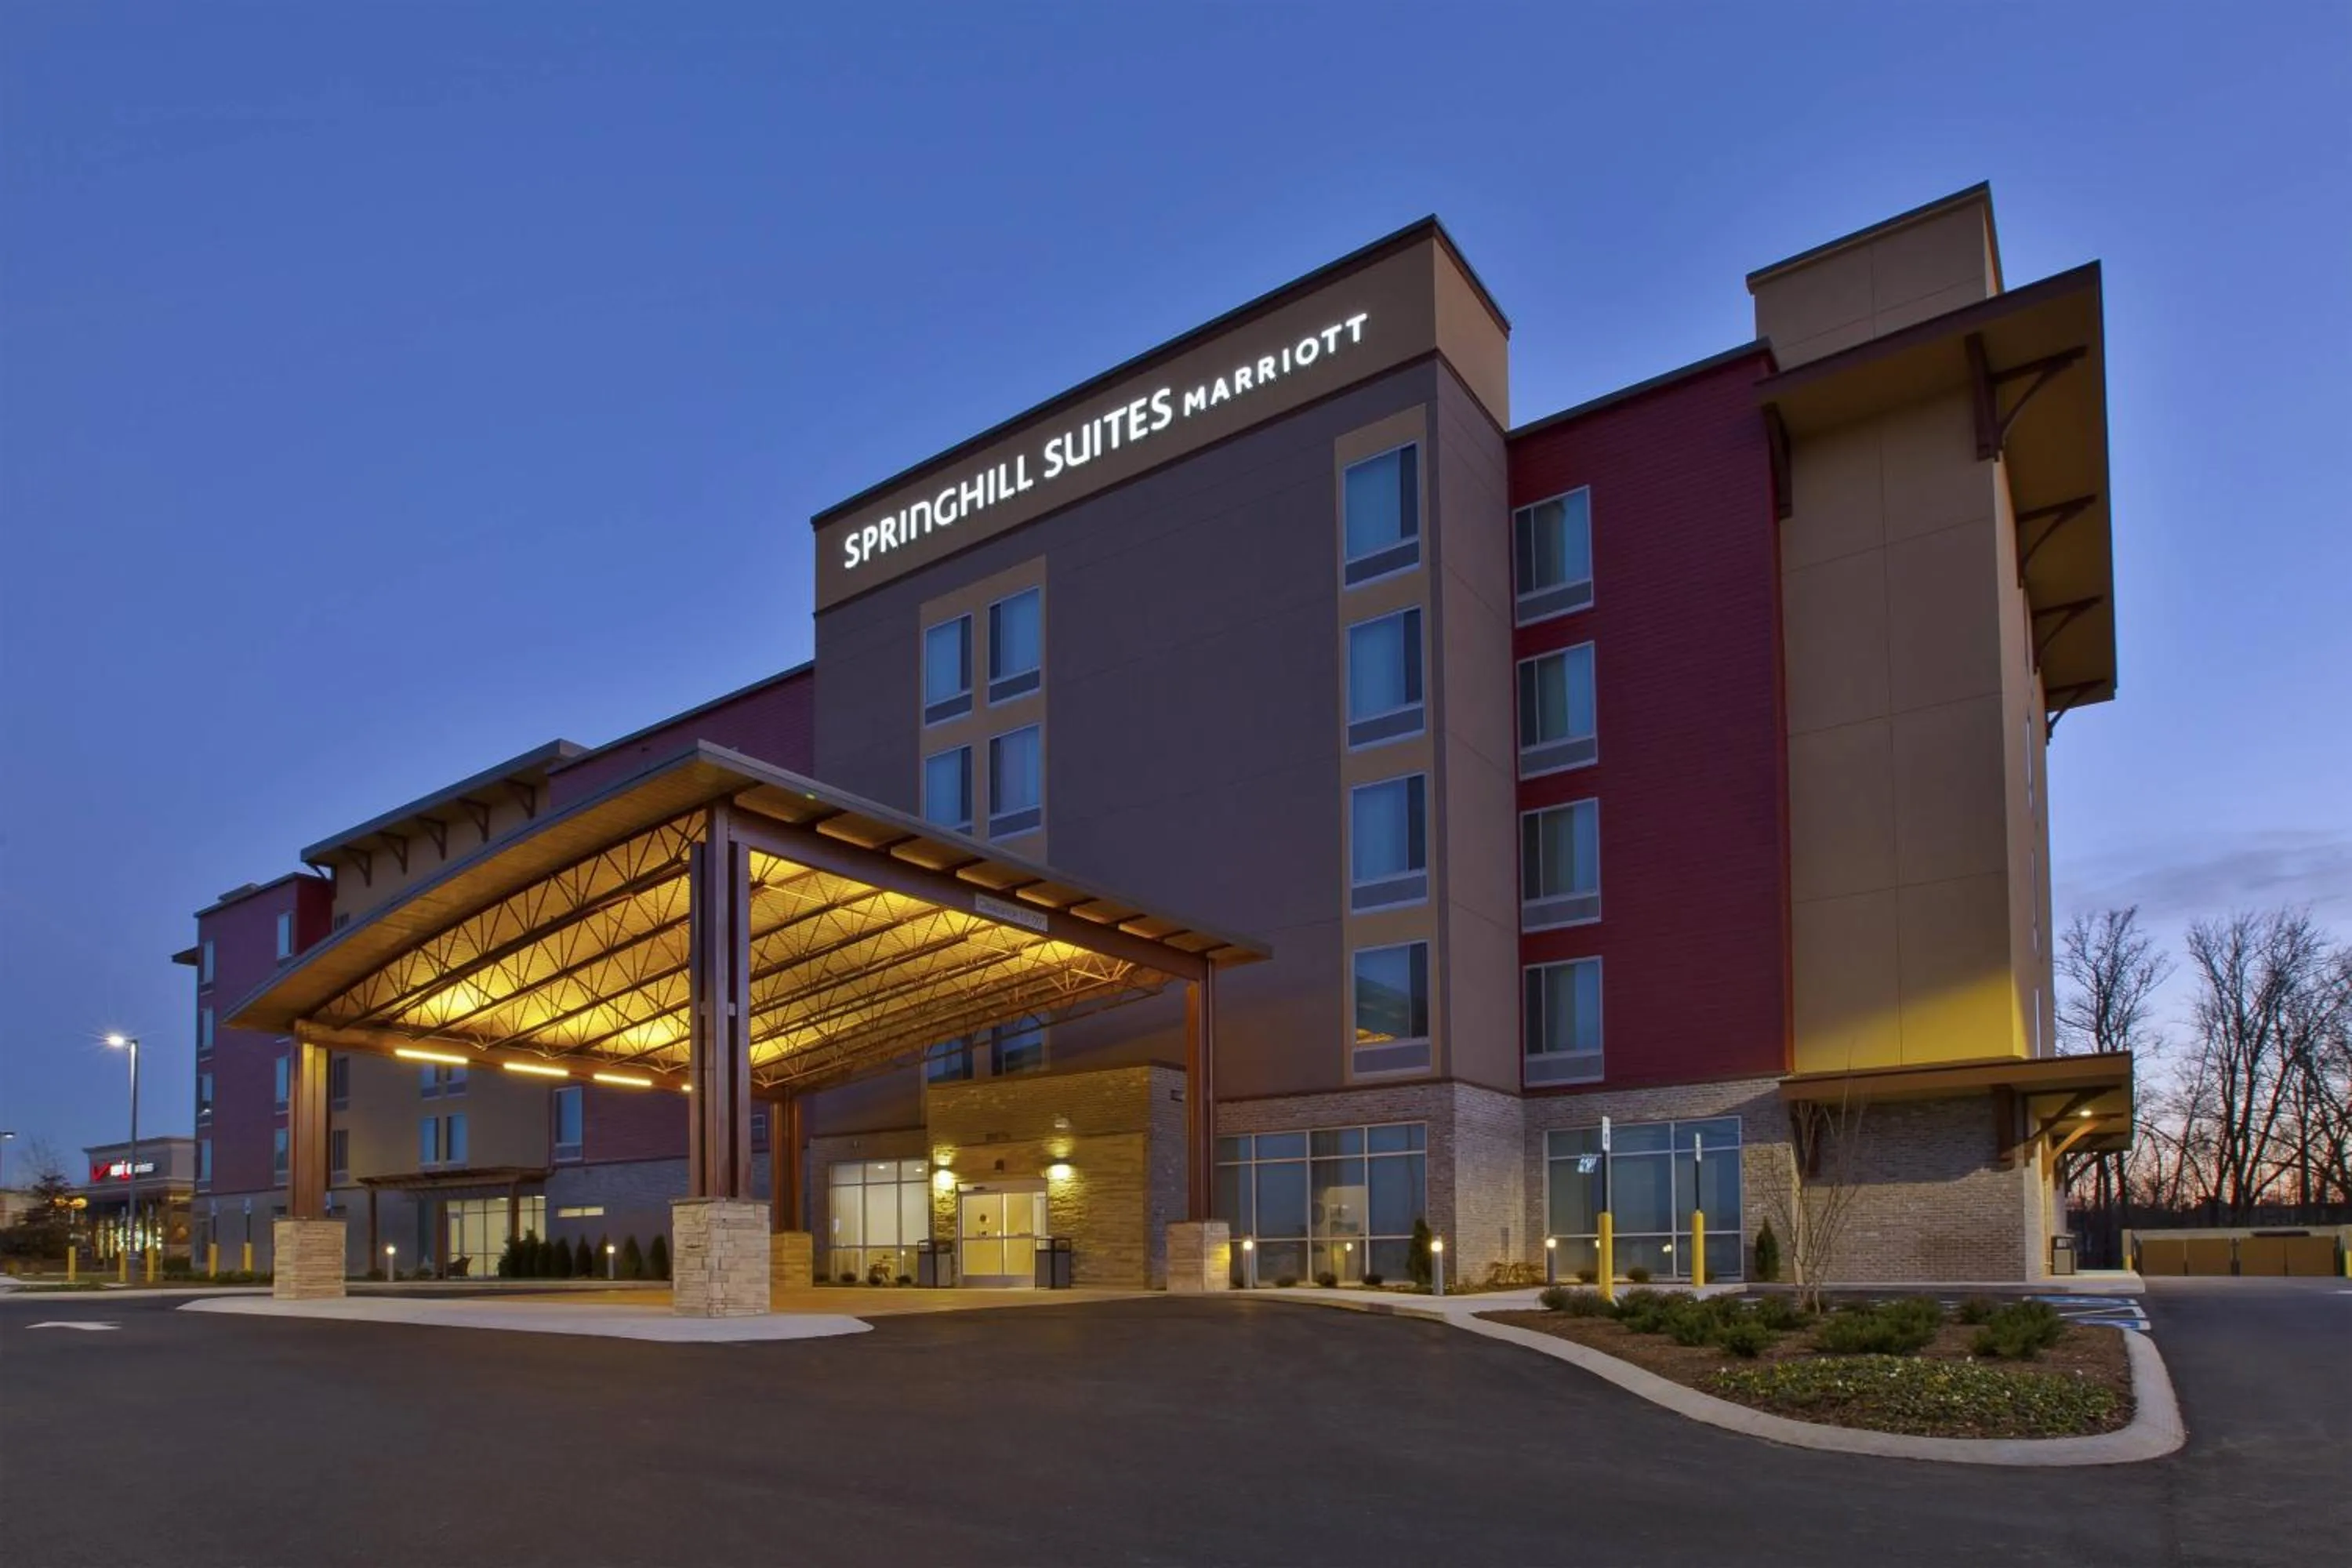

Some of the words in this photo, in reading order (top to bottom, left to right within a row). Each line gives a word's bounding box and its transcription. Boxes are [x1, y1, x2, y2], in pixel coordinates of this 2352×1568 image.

[844, 454, 1034, 569] SPRINGHILL
[1042, 387, 1173, 478] SUITES
[1182, 312, 1369, 417] MARRIOTT
